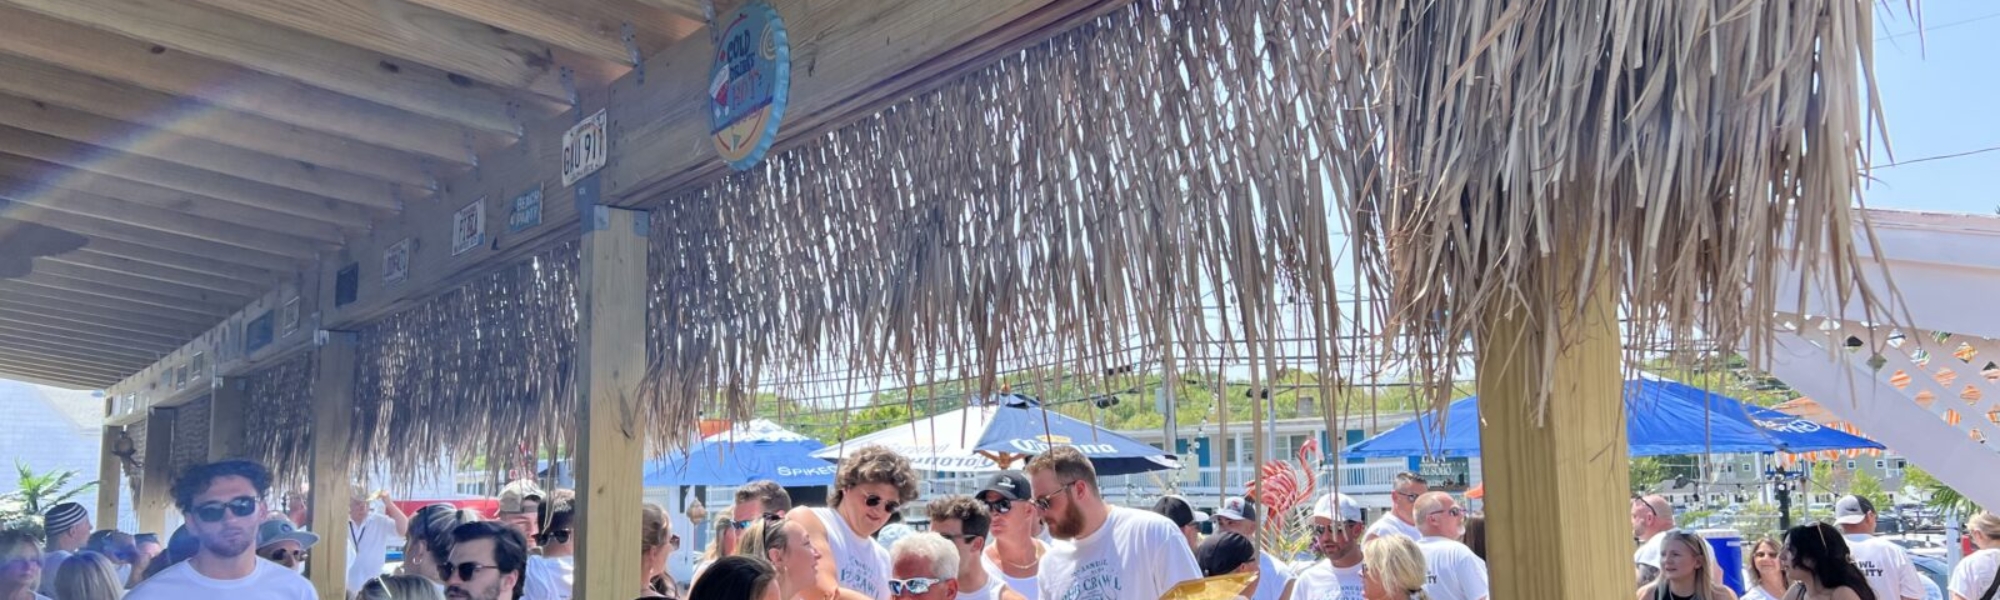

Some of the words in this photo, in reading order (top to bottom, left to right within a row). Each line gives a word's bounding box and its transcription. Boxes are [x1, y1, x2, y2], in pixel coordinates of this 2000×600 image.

[727, 29, 750, 63] COLD
[517, 189, 540, 211] BEACH
[1009, 438, 1118, 455] Cona
